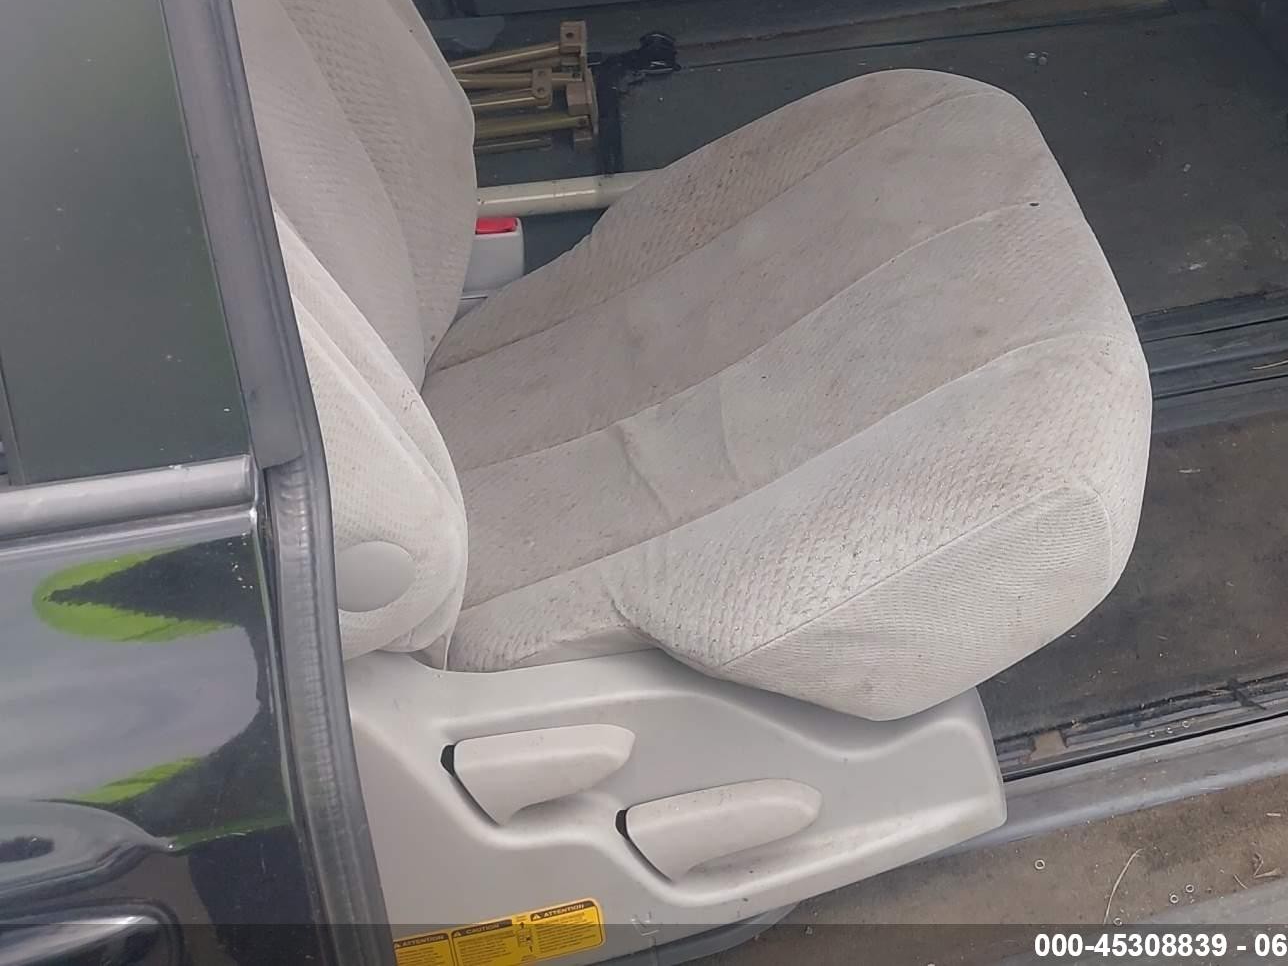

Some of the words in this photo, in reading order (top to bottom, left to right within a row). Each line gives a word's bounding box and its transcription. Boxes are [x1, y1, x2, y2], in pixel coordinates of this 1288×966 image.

[543, 903, 585, 919] ATTENTION
[465, 922, 500, 935] CAUTION
[401, 934, 446, 948] ATTENTION
